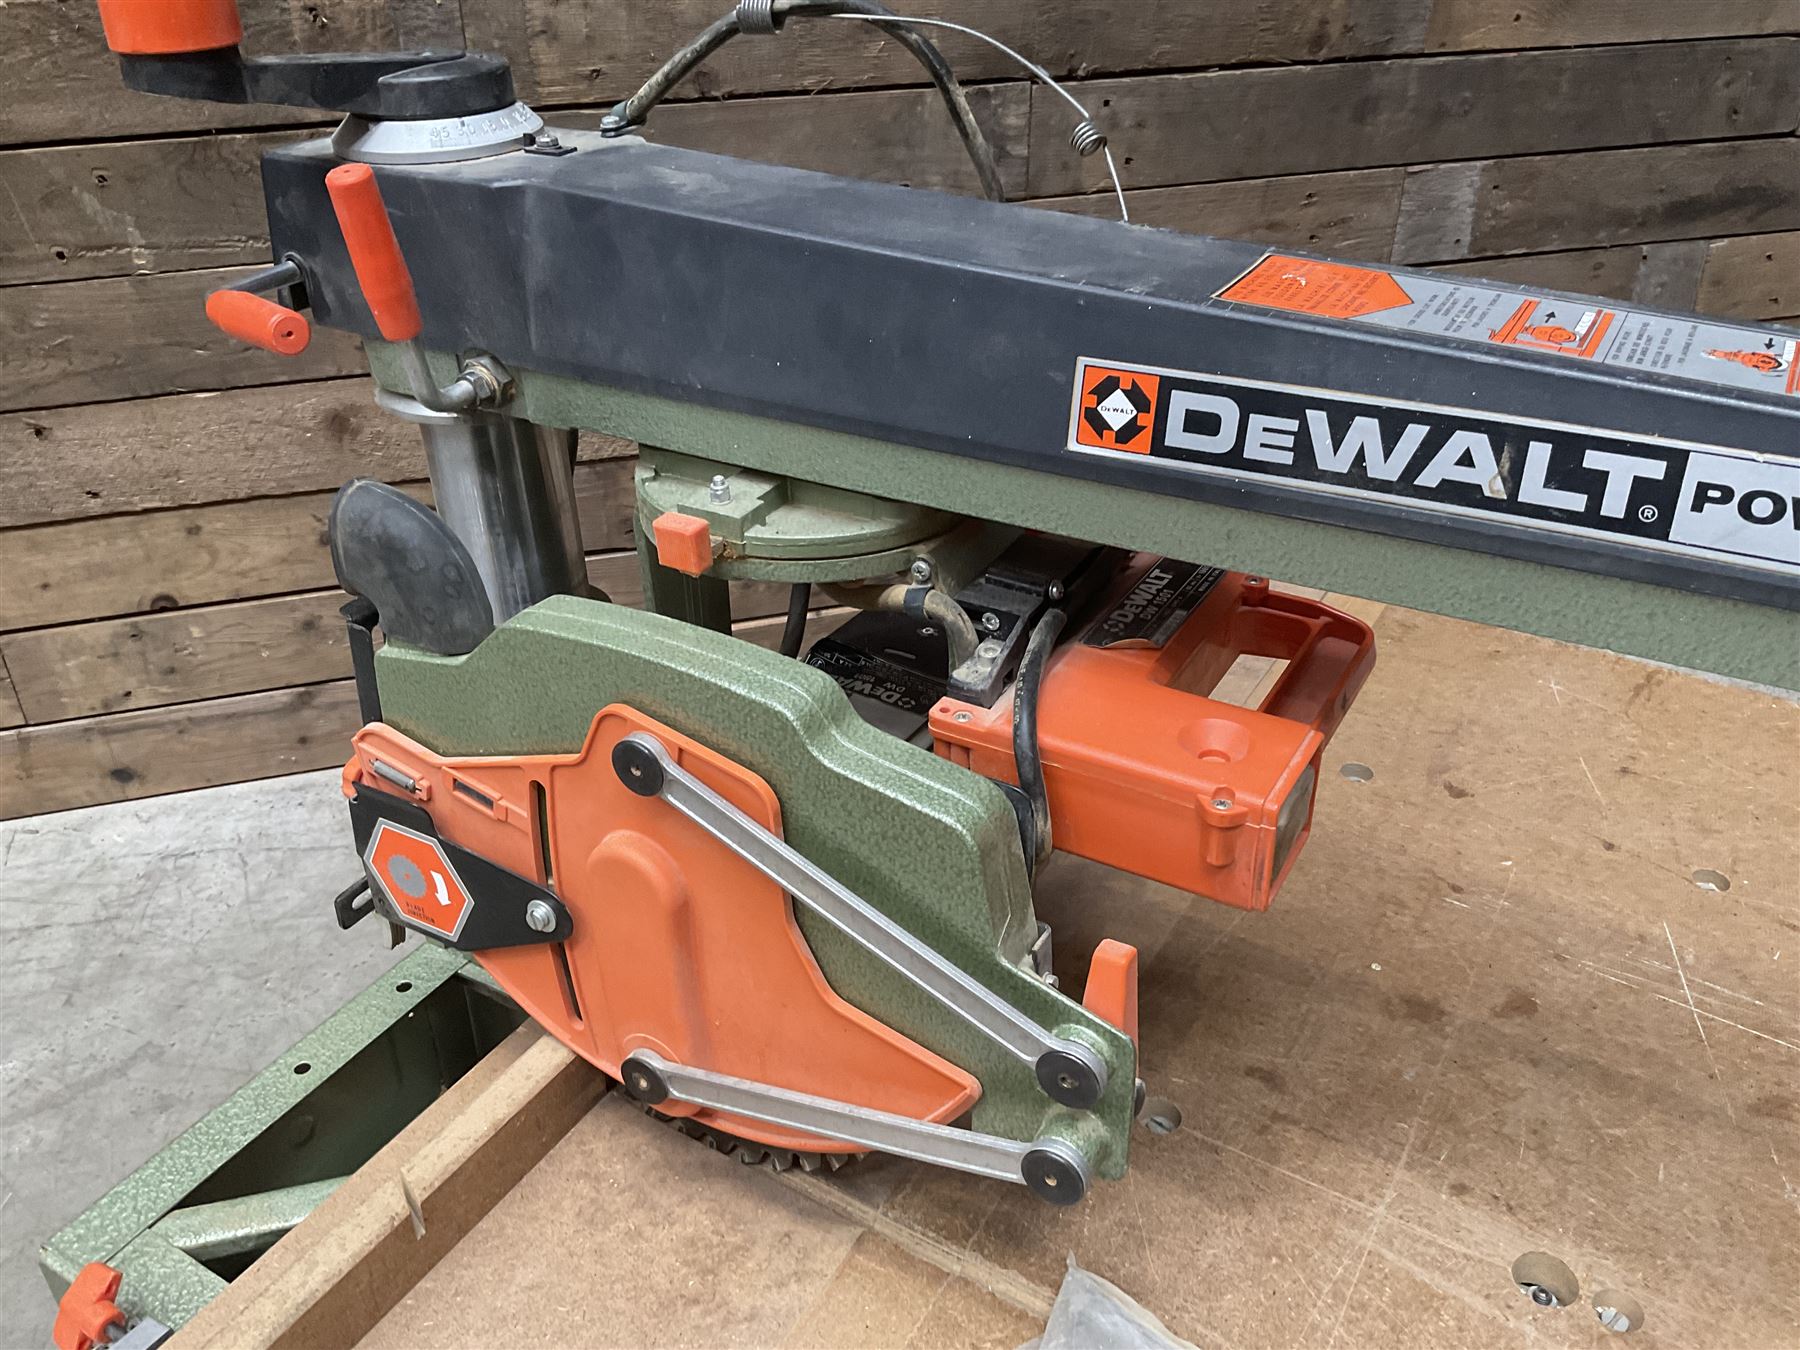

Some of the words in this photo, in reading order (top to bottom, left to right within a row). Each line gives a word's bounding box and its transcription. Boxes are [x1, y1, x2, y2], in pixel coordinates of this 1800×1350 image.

[1690, 480, 1800, 531] PO
[1140, 604, 1159, 620] DW
[1153, 589, 1174, 605] 1501
[882, 682, 906, 693] DW
